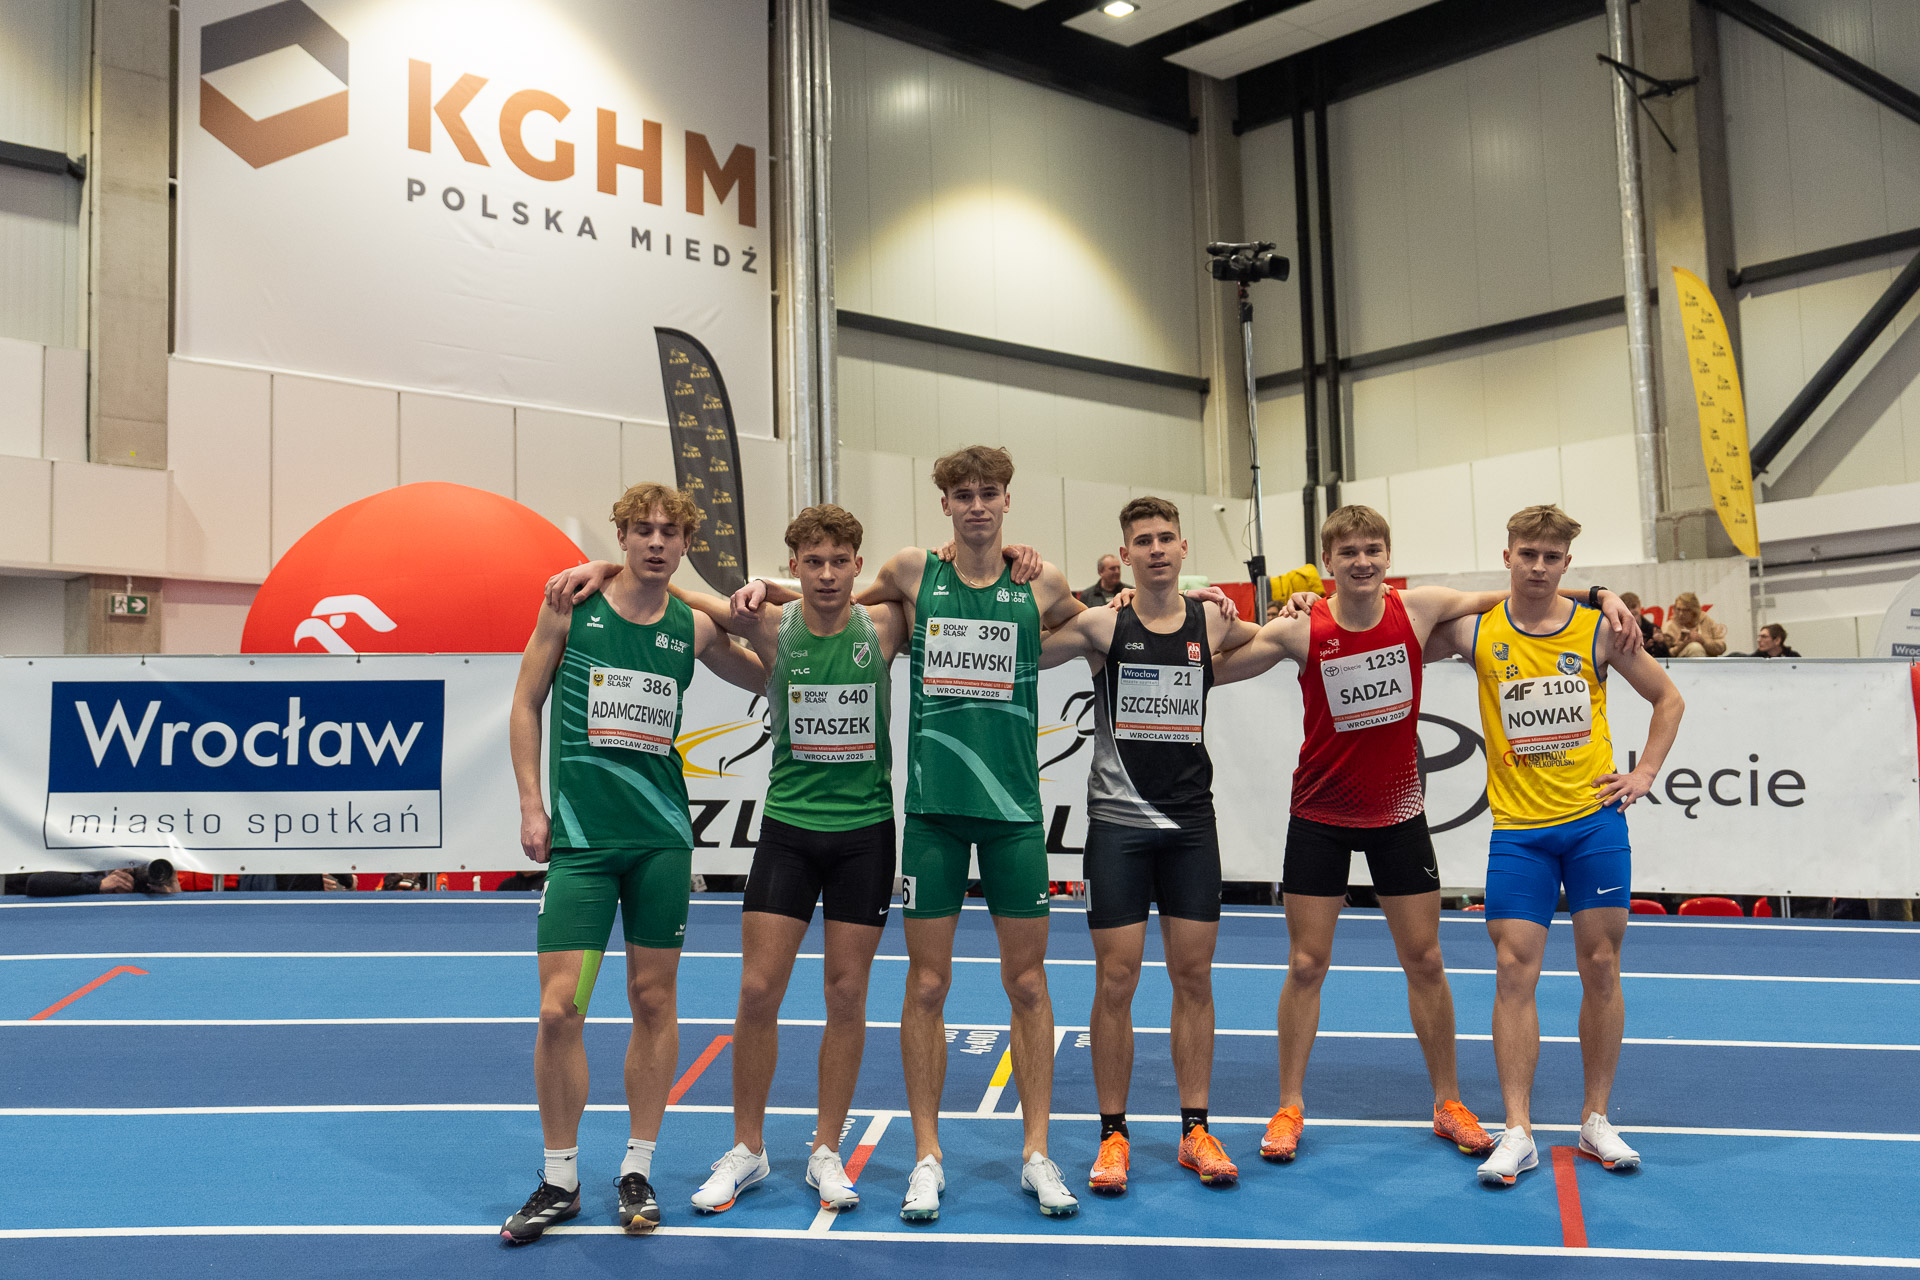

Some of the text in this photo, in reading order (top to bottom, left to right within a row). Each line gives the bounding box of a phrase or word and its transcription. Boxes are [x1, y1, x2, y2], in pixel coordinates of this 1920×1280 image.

[408, 58, 757, 228] KGHM
[407, 178, 757, 274] POLSKA MIEDŹ
[943, 629, 966, 637] ŚLĄSK
[978, 625, 1010, 642] 390
[1124, 642, 1145, 650] esa
[928, 650, 1012, 673] MAJEWSKI
[1365, 649, 1406, 671] 1233
[607, 674, 634, 682] DOLNY
[642, 678, 672, 697] 386
[1173, 671, 1192, 687] 21
[838, 689, 868, 705] 640
[936, 687, 1000, 698] WROCŁAW 2025
[1340, 678, 1402, 705] SADZA
[1504, 682, 1535, 701] 4F
[1542, 680, 1586, 696] 1100
[591, 701, 674, 728] ADAMCZEWSKI
[1121, 694, 1199, 718] SZCZĘŚNIAK
[794, 716, 871, 735] STASZEK
[1347, 711, 1405, 729] WROCŁAW 2025
[1508, 705, 1585, 730] NOWAK
[75, 697, 424, 768] Wrocław
[1130, 732, 1172, 740] WROCŁAW
[600, 738, 659, 752] WROCŁAW 2025
[1516, 741, 1580, 753] WROCŁAW 2025
[804, 753, 845, 761] WROCŁAW
[1527, 759, 1575, 768] WIELKOPOLSKI
[1628, 750, 1806, 819] ęcie
[69, 801, 419, 842] miasto spotkań
[903, 878, 910, 905] 6
[959, 1030, 1000, 1055] 4x400
